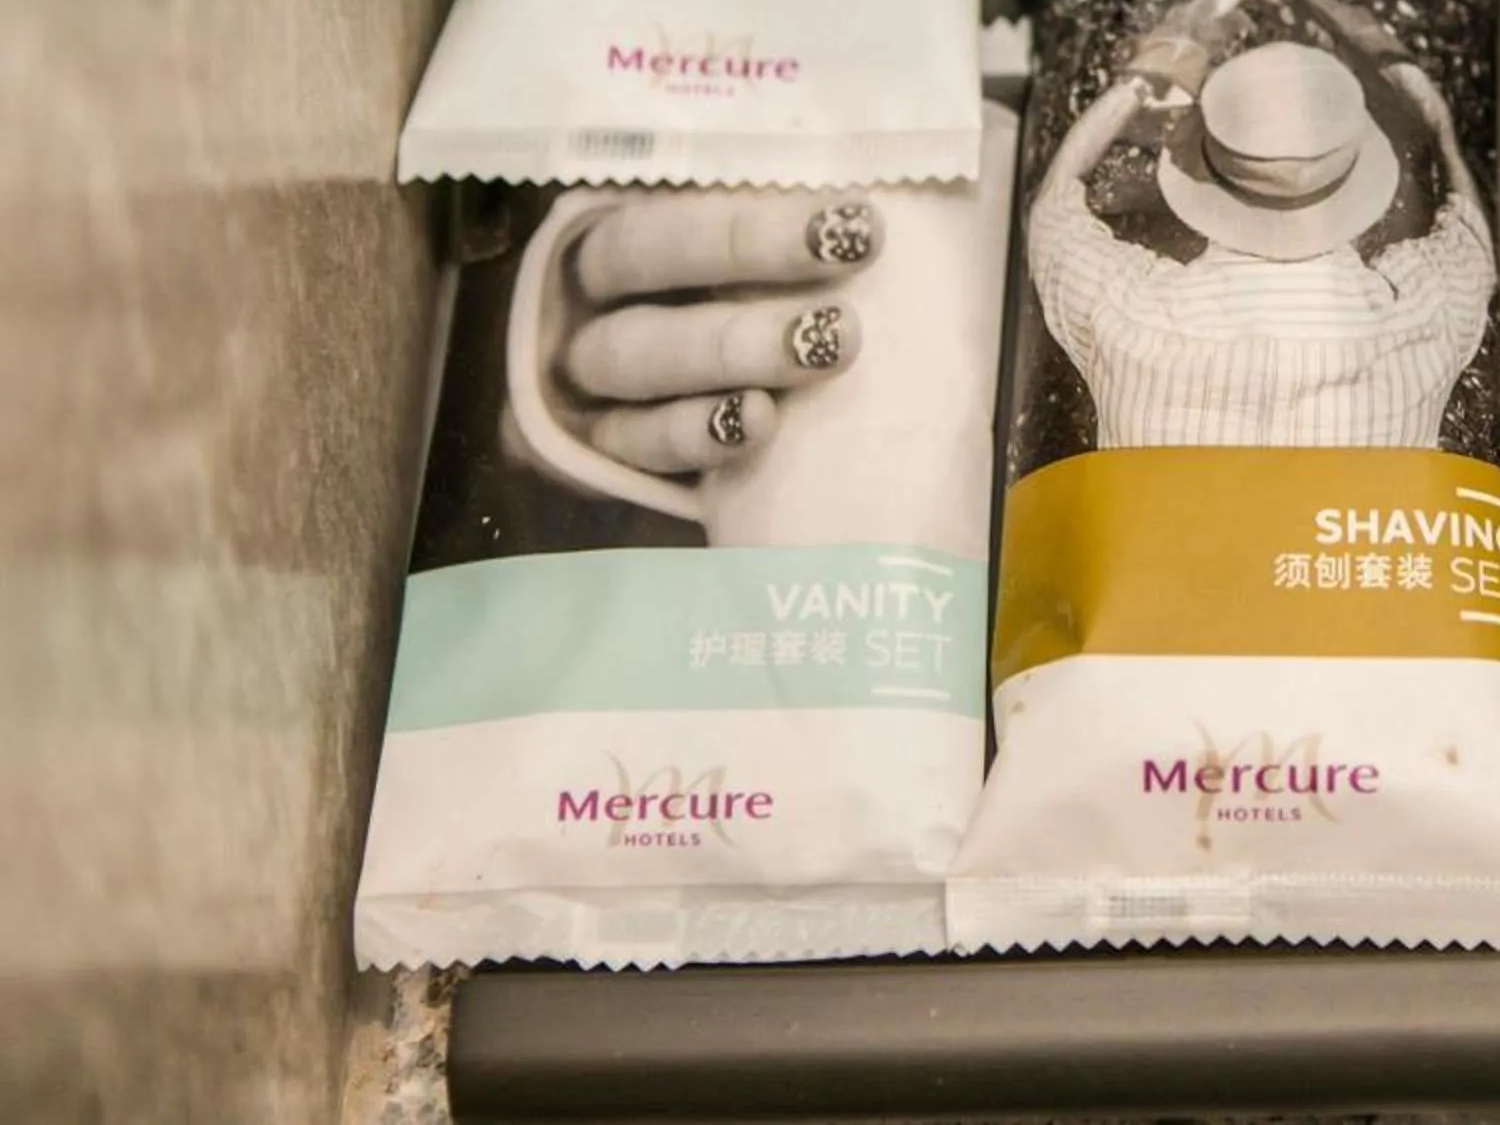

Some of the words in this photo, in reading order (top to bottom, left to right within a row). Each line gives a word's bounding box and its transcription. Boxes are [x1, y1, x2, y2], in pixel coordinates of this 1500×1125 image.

[607, 44, 800, 84] Mercure
[1273, 551, 1434, 591] 须刨套装
[766, 582, 955, 624] VANITY
[689, 627, 848, 669] 护理套装
[864, 627, 954, 674] SET
[1142, 758, 1381, 795] Mercure
[557, 787, 774, 823] Mercure
[1216, 806, 1302, 822] HOTELS
[623, 832, 702, 848] HOTELS
